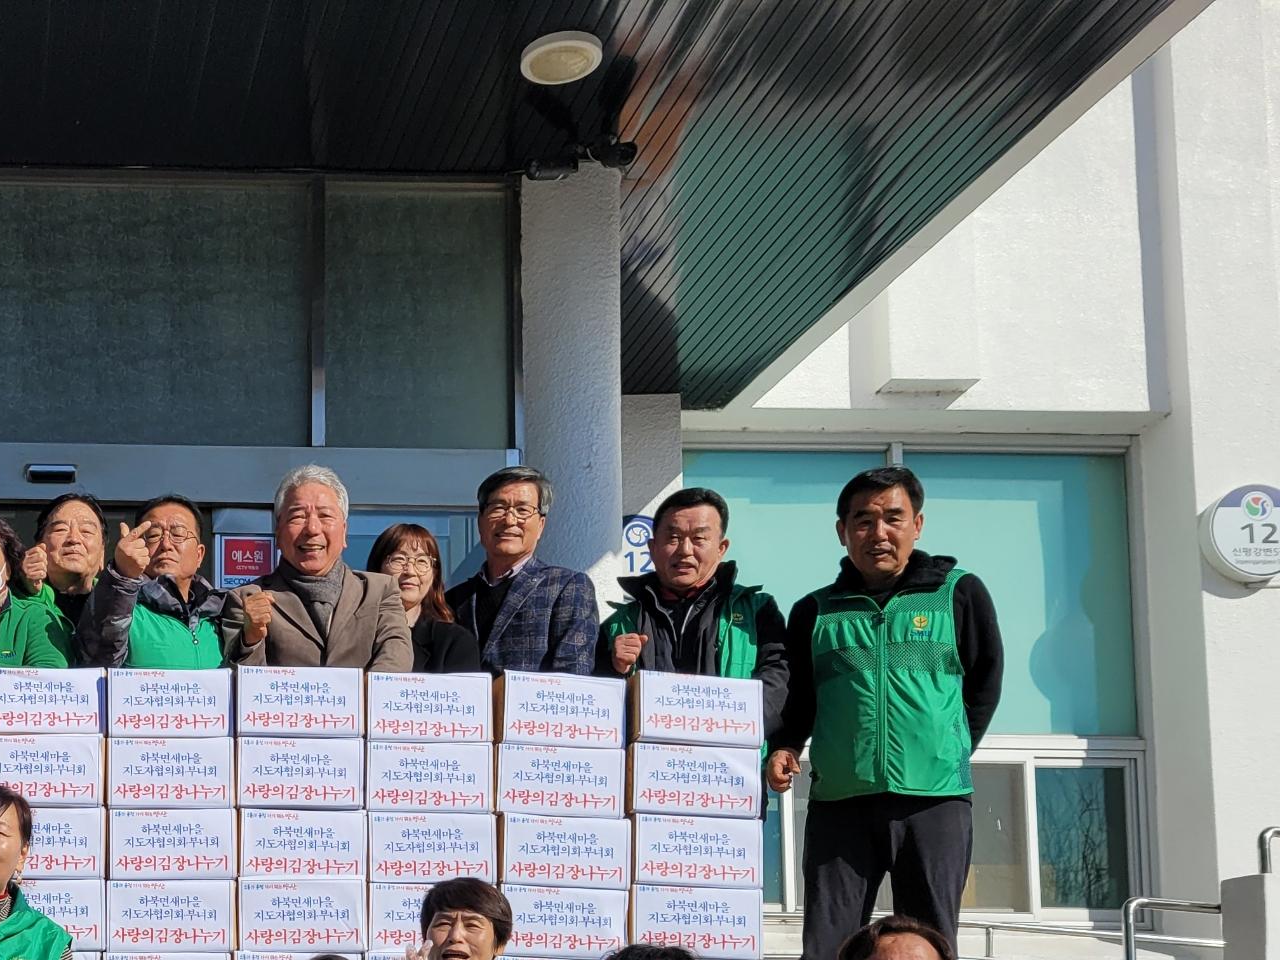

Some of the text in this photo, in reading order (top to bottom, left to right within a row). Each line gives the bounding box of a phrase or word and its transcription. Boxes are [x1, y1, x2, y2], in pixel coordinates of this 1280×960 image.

[1240, 523, 1280, 544] 12
[231, 549, 264, 563] 에스원
[624, 551, 652, 573] 12
[12, 681, 73, 693] 하북면새마을
[139, 682, 202, 695] 하북면새마을
[269, 681, 331, 694] 하북면새마을
[671, 683, 732, 699] 하북면새마을
[399, 689, 461, 703] 하북면새마을
[535, 690, 596, 706] 하북면새마을
[114, 713, 225, 730] 사랑의김장나누기
[243, 710, 354, 730] 사랑의김장나누기
[373, 717, 483, 739] 사랑의김장나누기
[646, 712, 755, 736] 사랑의김장나누기
[509, 718, 618, 743] 사랑의김장나누기
[8, 749, 70, 764] 하북면새마을
[140, 752, 202, 764] 하북면새마을
[269, 752, 332, 766] 하북면새마을
[398, 757, 461, 772] 하북면새마을
[530, 758, 593, 774] 하북면새마을
[666, 758, 729, 774] 하북면새마을
[114, 782, 226, 800] 사랑의김장나누기
[243, 782, 355, 802] 사랑의김장나누기
[372, 787, 484, 808] 사랑의김장나누기
[638, 787, 752, 811] 사랑의김장나누기
[502, 788, 616, 811] 사랑의김장나누기
[29, 822, 71, 835] 면새마을
[141, 823, 204, 836] 하북면새마을
[272, 825, 335, 839] 하북면새마을
[400, 828, 464, 841] 하북면새마을
[535, 830, 599, 845] 하북면새마을
[667, 830, 731, 846] 하북면새마을
[26, 853, 95, 871] 김장나누기
[115, 855, 228, 872] 사랑의김장나누기
[246, 856, 358, 876] 사랑의김장나누기
[375, 859, 488, 877] 사랑의김장나누기
[509, 861, 622, 883] 사랑의김장나누기
[641, 859, 754, 883] 사랑의김장나누기
[138, 895, 202, 908] 하북면새마을
[270, 896, 334, 909] 하북면새마을
[532, 899, 597, 914] 하북면새마을
[666, 899, 731, 914] 하북면새마을
[112, 926, 225, 945] 사랑의김장나누기
[245, 928, 359, 945] 사랑의김장나누기
